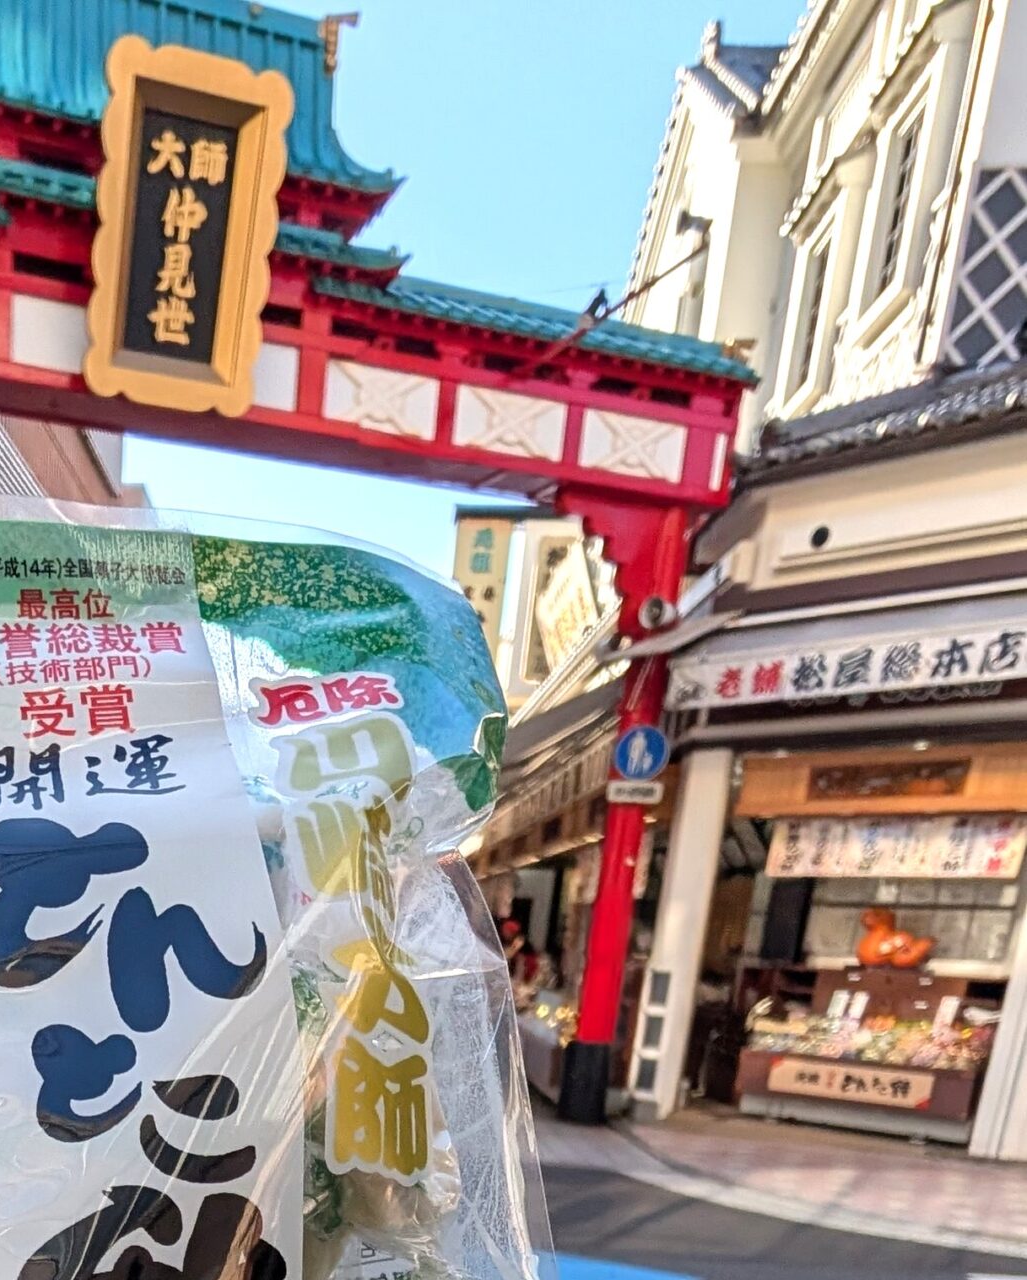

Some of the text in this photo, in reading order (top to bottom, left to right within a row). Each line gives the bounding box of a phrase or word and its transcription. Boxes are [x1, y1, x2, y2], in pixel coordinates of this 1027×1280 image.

[146, 128, 229, 187] 大師
[146, 184, 209, 346] 仲見世
[16, 588, 115, 621] 最高位
[19, 684, 137, 739] 受賞
[257, 675, 400, 725] 厄除
